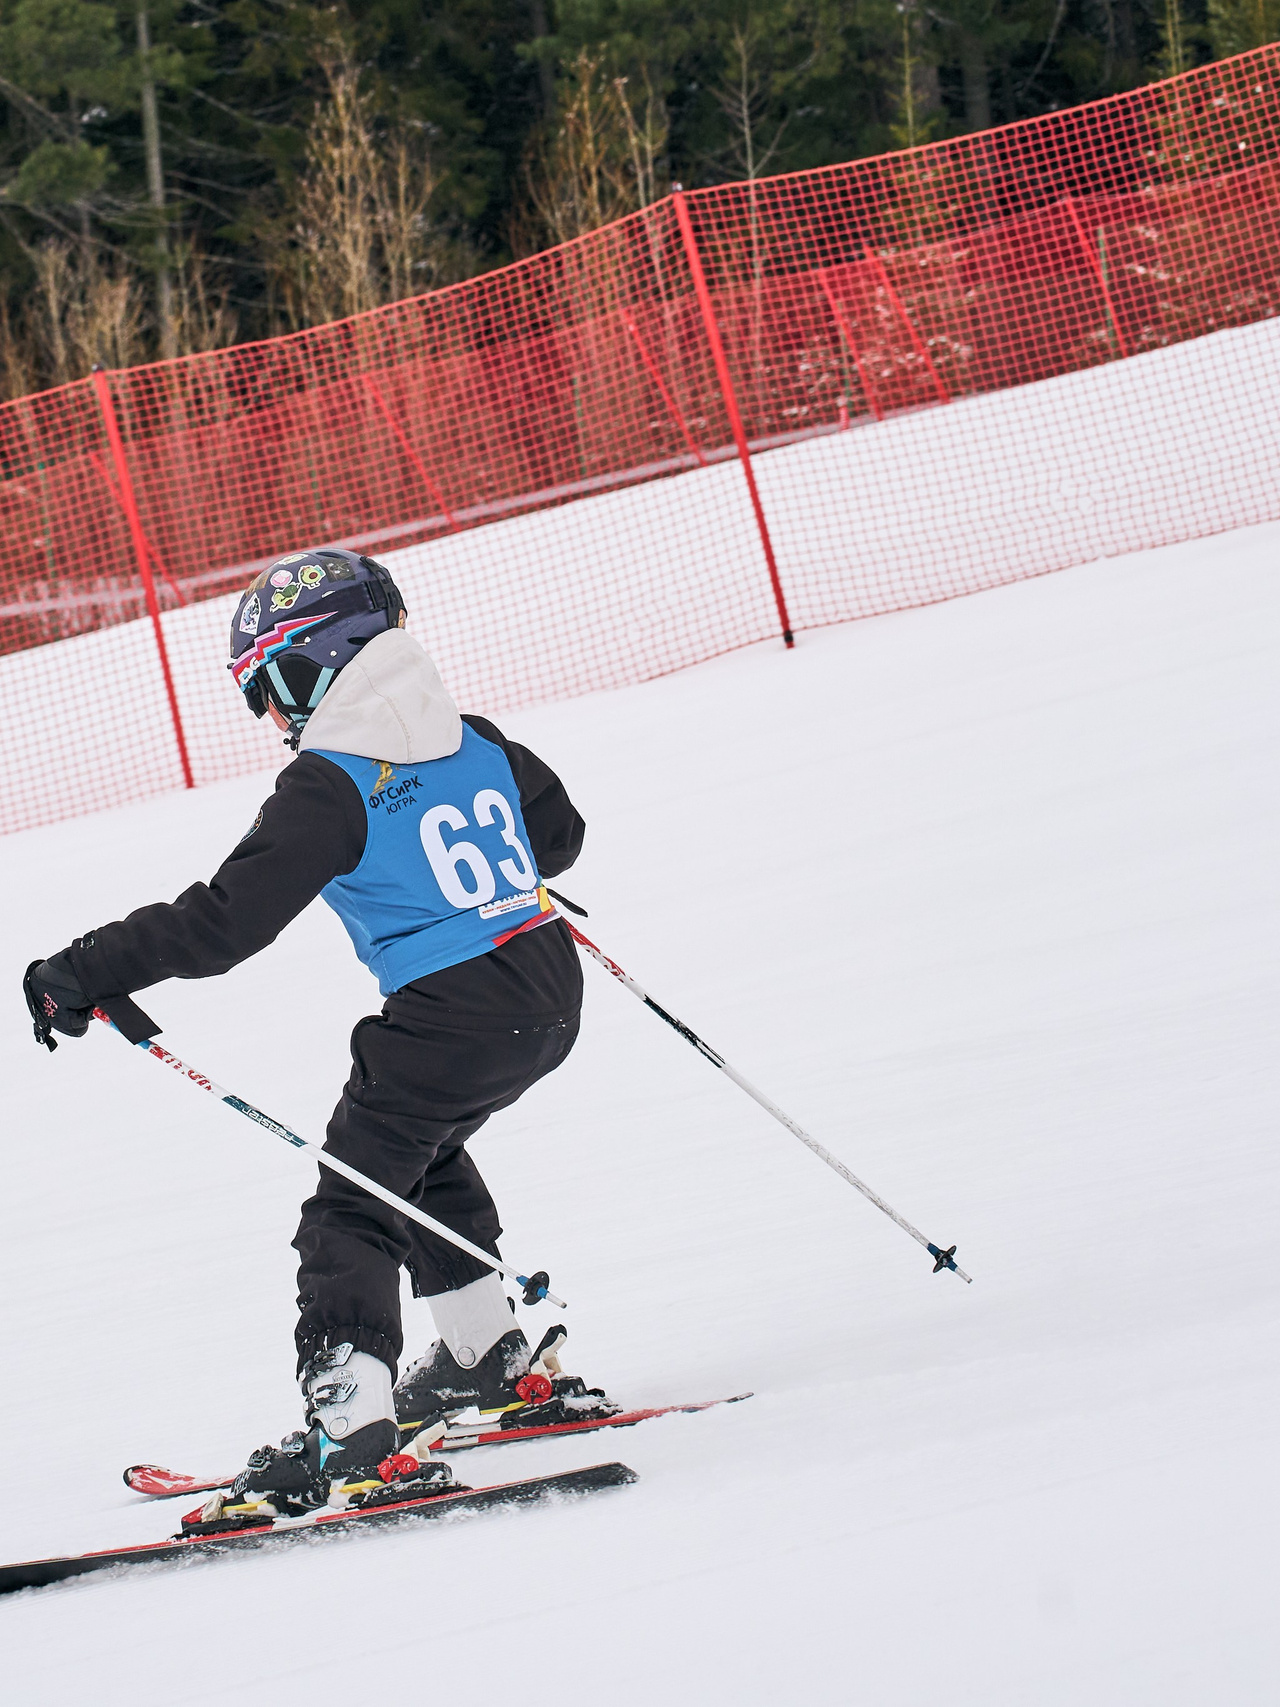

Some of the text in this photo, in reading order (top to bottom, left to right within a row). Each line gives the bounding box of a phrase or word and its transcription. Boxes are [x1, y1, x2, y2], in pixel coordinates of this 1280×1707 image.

[368, 775, 424, 809] ФГСиРК
[386, 795, 418, 815] ЮГРА
[420, 788, 538, 909] 63
